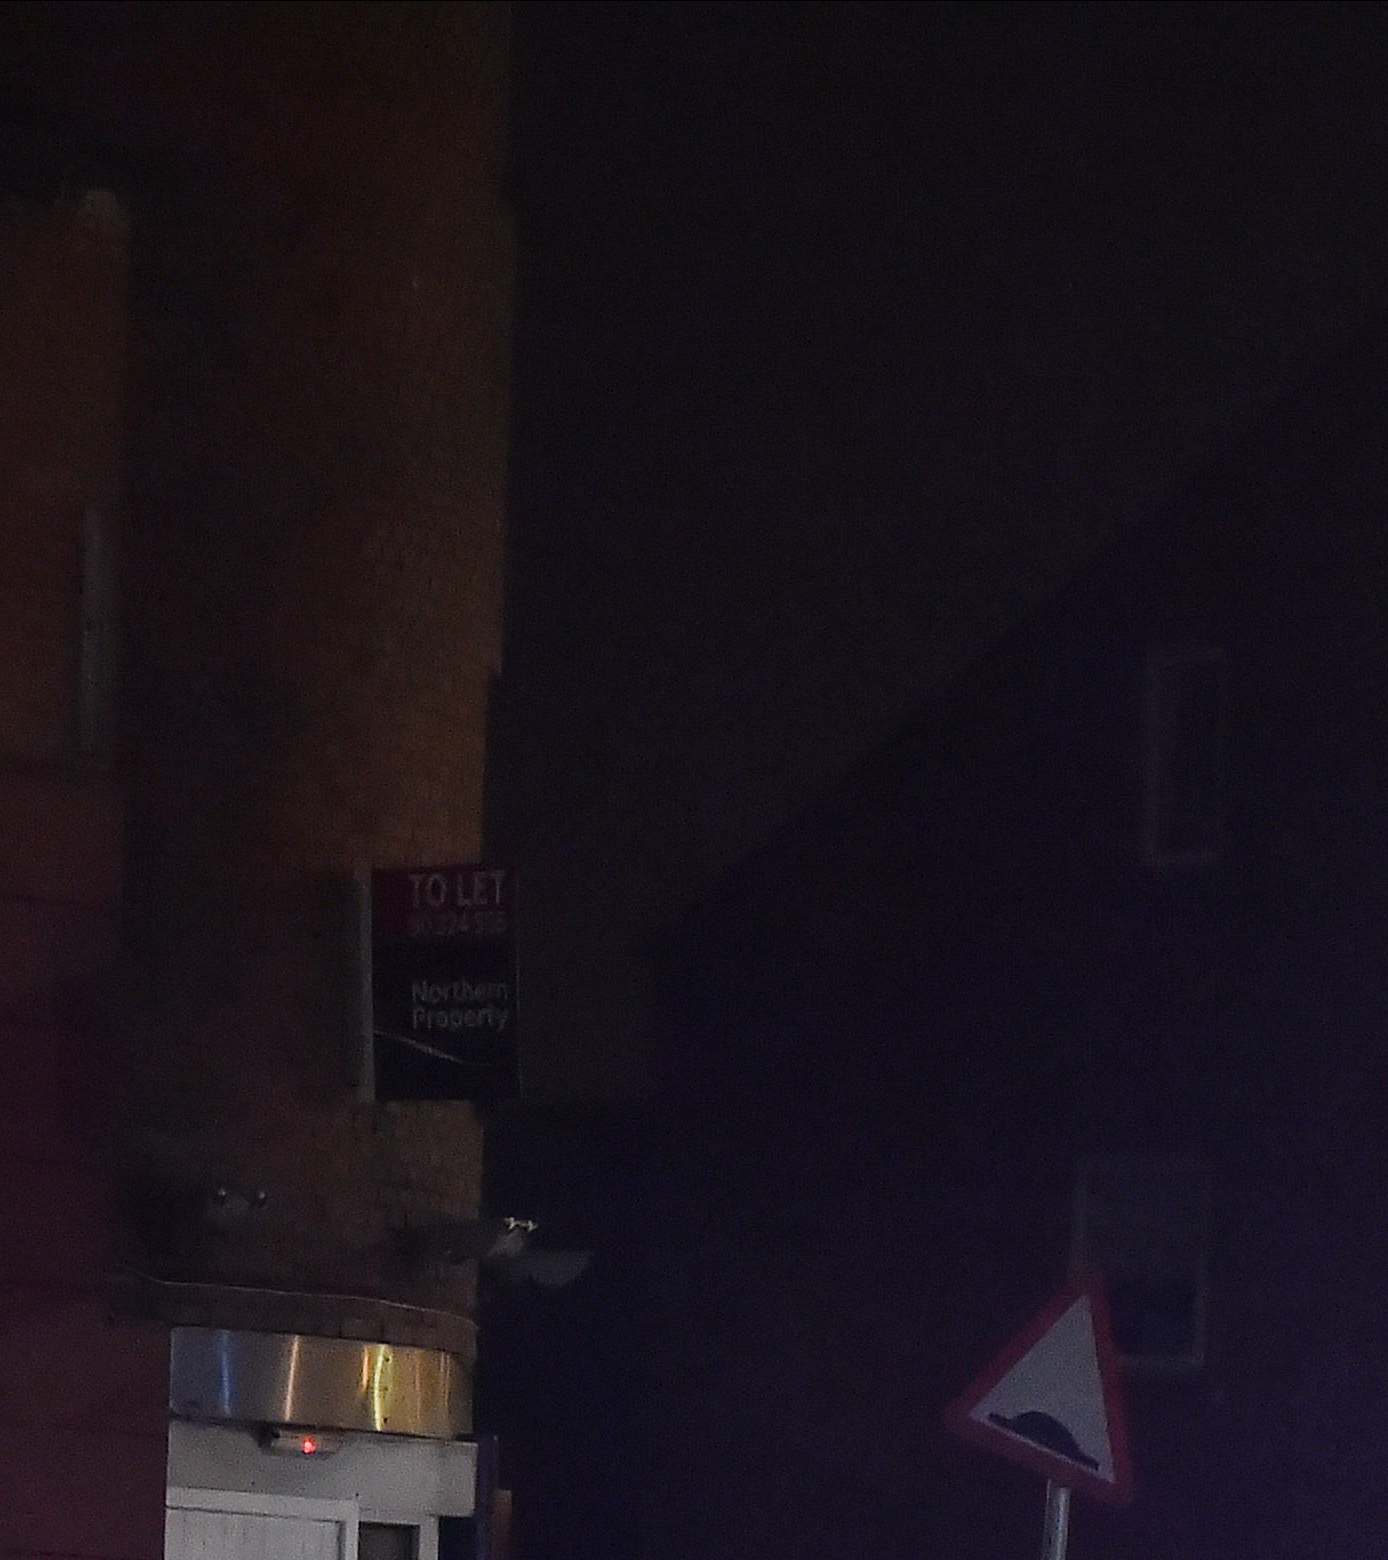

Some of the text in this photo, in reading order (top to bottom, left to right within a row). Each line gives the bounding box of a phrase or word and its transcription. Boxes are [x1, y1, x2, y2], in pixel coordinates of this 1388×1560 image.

[408, 869, 507, 908] TO LET
[411, 977, 508, 1003] Northern
[411, 1004, 509, 1032] Property
